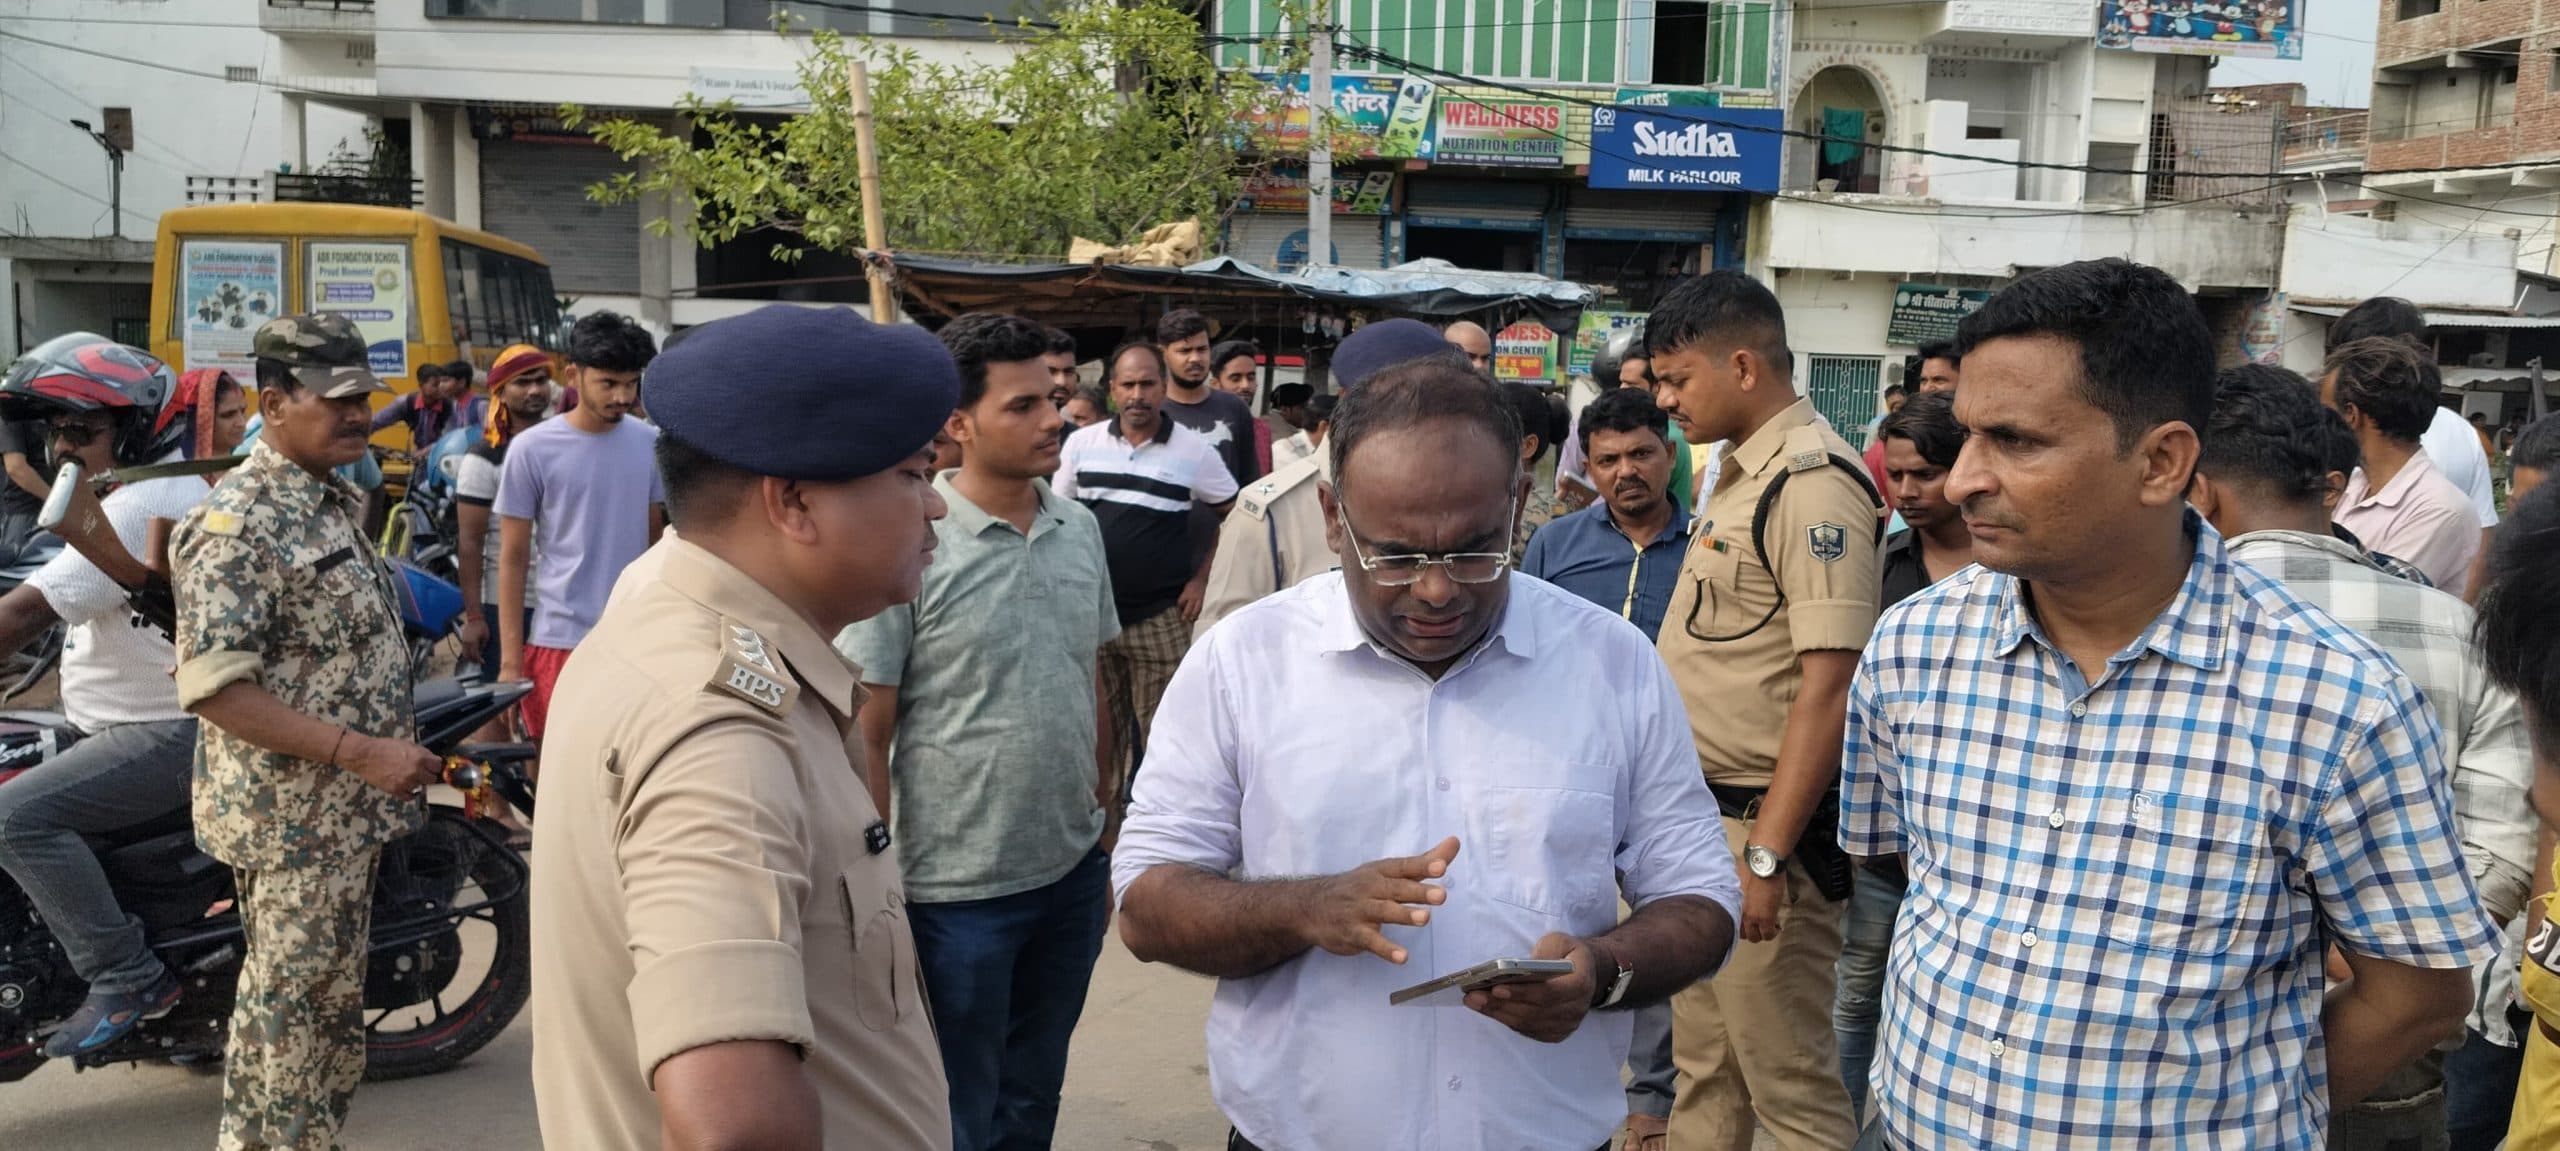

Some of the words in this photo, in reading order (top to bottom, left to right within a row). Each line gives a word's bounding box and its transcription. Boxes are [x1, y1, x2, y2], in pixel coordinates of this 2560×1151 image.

[1444, 102, 1560, 130] WELLNESS
[1442, 137, 1509, 152] NUTRITION
[1513, 140, 1559, 154] CENTRE
[1632, 120, 1741, 157] Sudha
[1628, 169, 1664, 183] MILK
[1670, 171, 1741, 185] PARLOUR
[332, 251, 372, 264] FOUNDATION
[374, 252, 400, 264] SCHOOL
[726, 663, 786, 706] BPS
